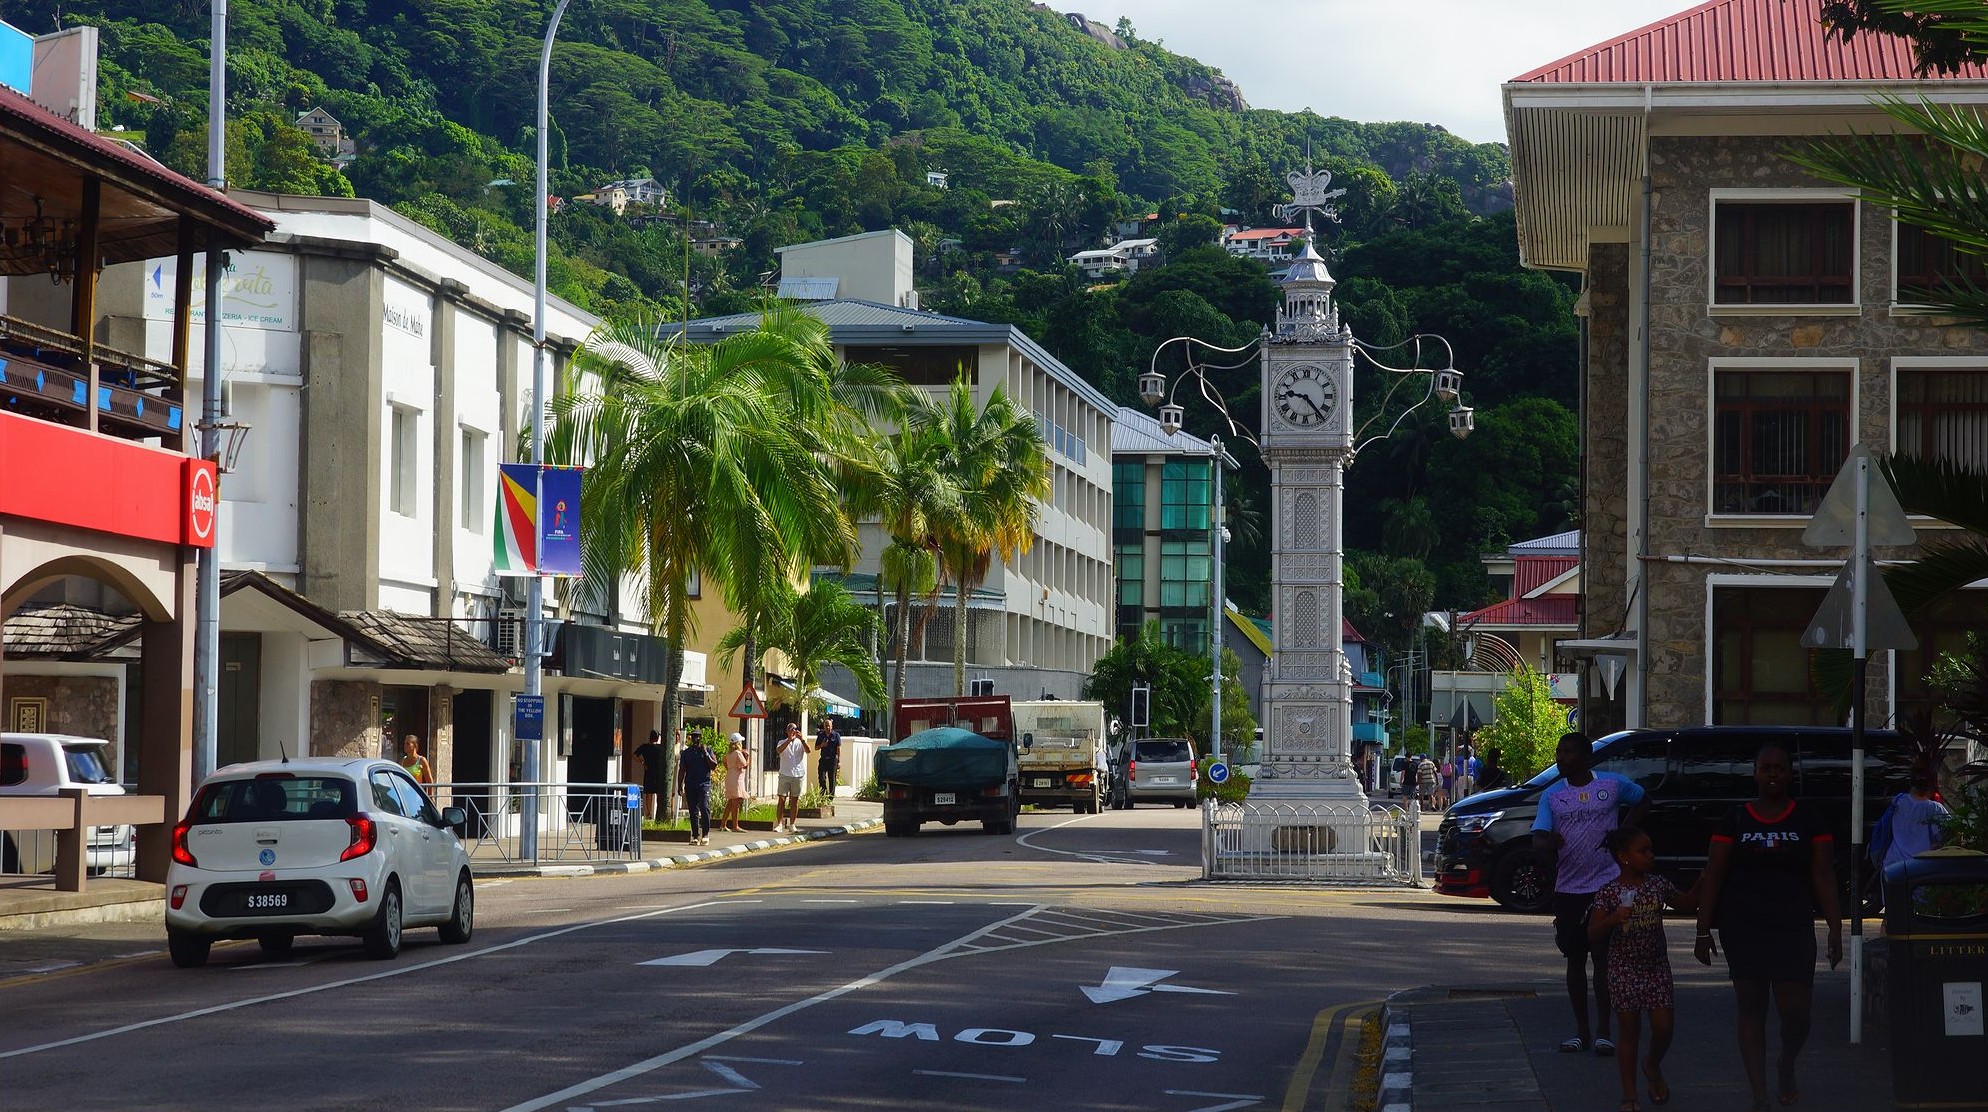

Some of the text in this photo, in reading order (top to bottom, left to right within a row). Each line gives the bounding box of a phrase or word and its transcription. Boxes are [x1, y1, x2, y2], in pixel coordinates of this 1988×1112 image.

[259, 316, 283, 324] CREAM
[383, 302, 402, 327] Maison
[402, 308, 409, 330] de
[194, 488, 211, 512] absa
[1741, 832, 1800, 842] PARIS
[1929, 945, 1985, 955] LITTER
[847, 1019, 1221, 1063] SLOW
